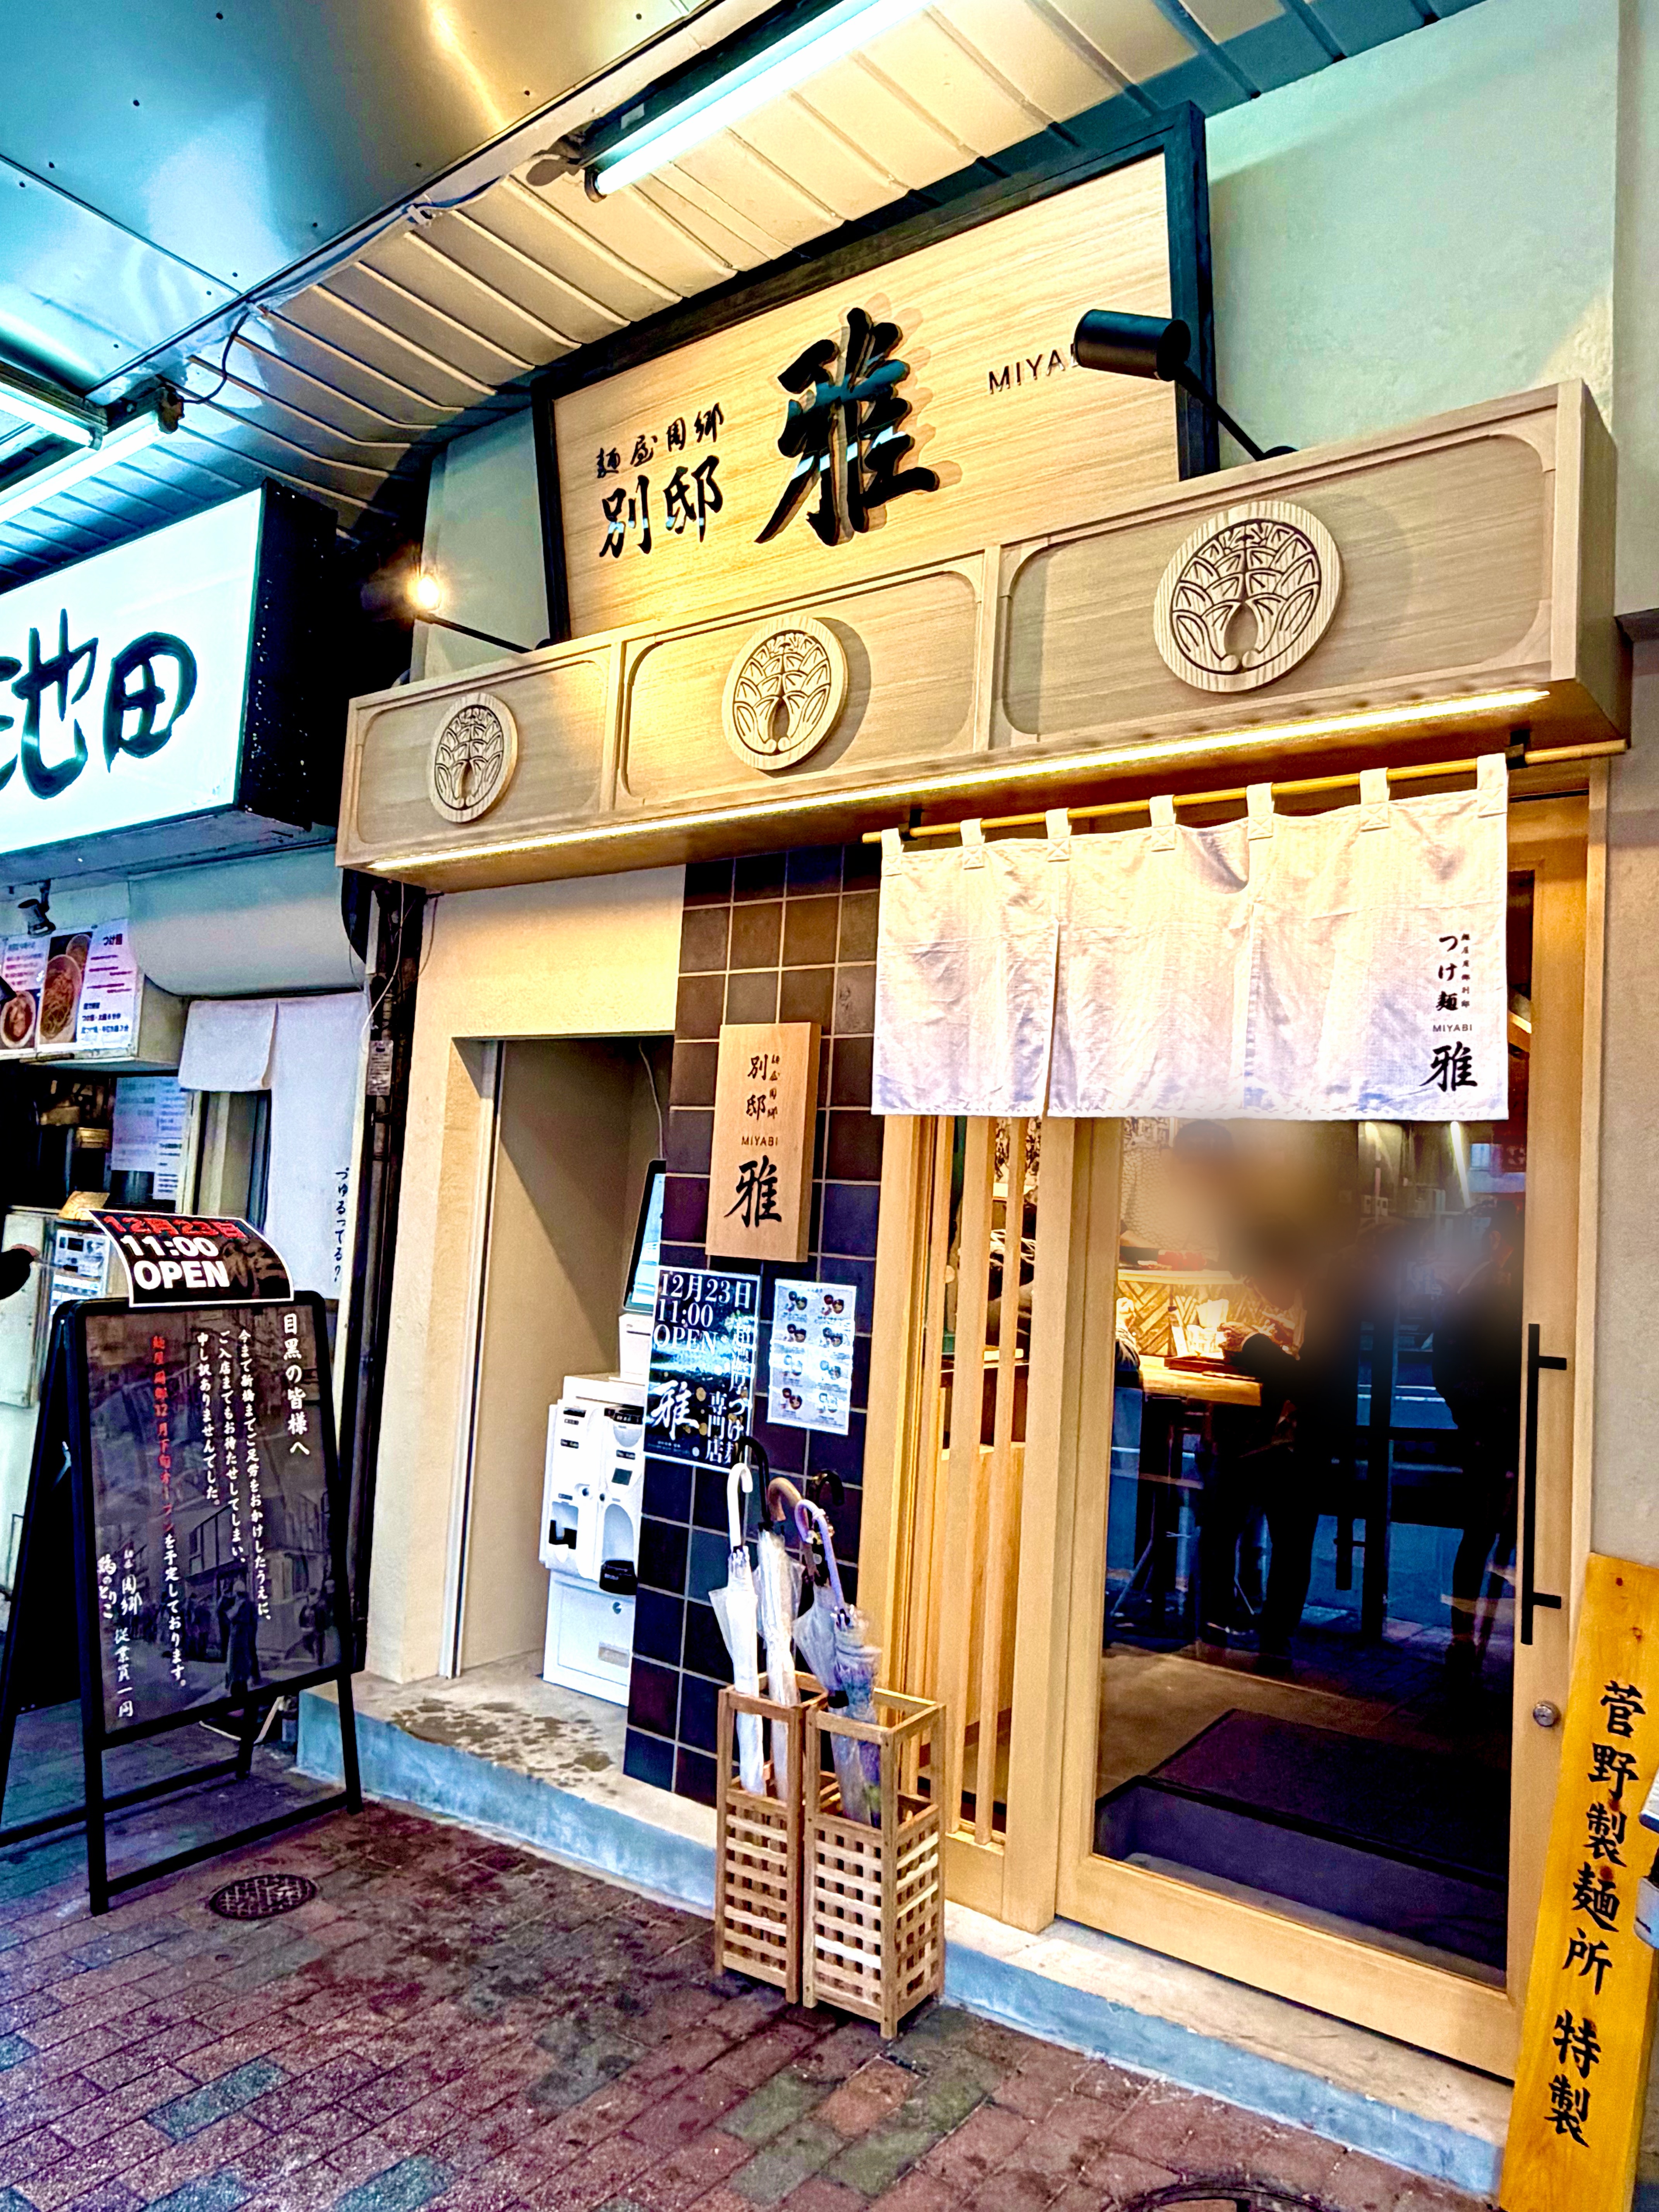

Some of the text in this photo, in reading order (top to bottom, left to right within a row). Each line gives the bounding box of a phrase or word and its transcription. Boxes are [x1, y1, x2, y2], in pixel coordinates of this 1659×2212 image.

[755, 307, 939, 546] 雅
[599, 455, 723, 558] 別邸
[1436, 936, 1458, 1011] つけ麺
[746, 1054, 768, 1120] 別邸
[1419, 1041, 1477, 1092] 雅
[741, 1135, 778, 1147] MIYABI
[724, 1155, 781, 1228] 雅
[120, 1235, 218, 1257] 11:00
[134, 1260, 230, 1290] OPEN
[658, 1299, 713, 1328] 11:00
[660, 1273, 751, 1309] 12月23日
[653, 1324, 718, 1355] OPEN
[284, 1313, 310, 1455] 目黒の皆様へ
[647, 1380, 699, 1441] 雅
[705, 1391, 727, 1463] 専門店
[1544, 1680, 1646, 2148] 菅野製麺所 特製
